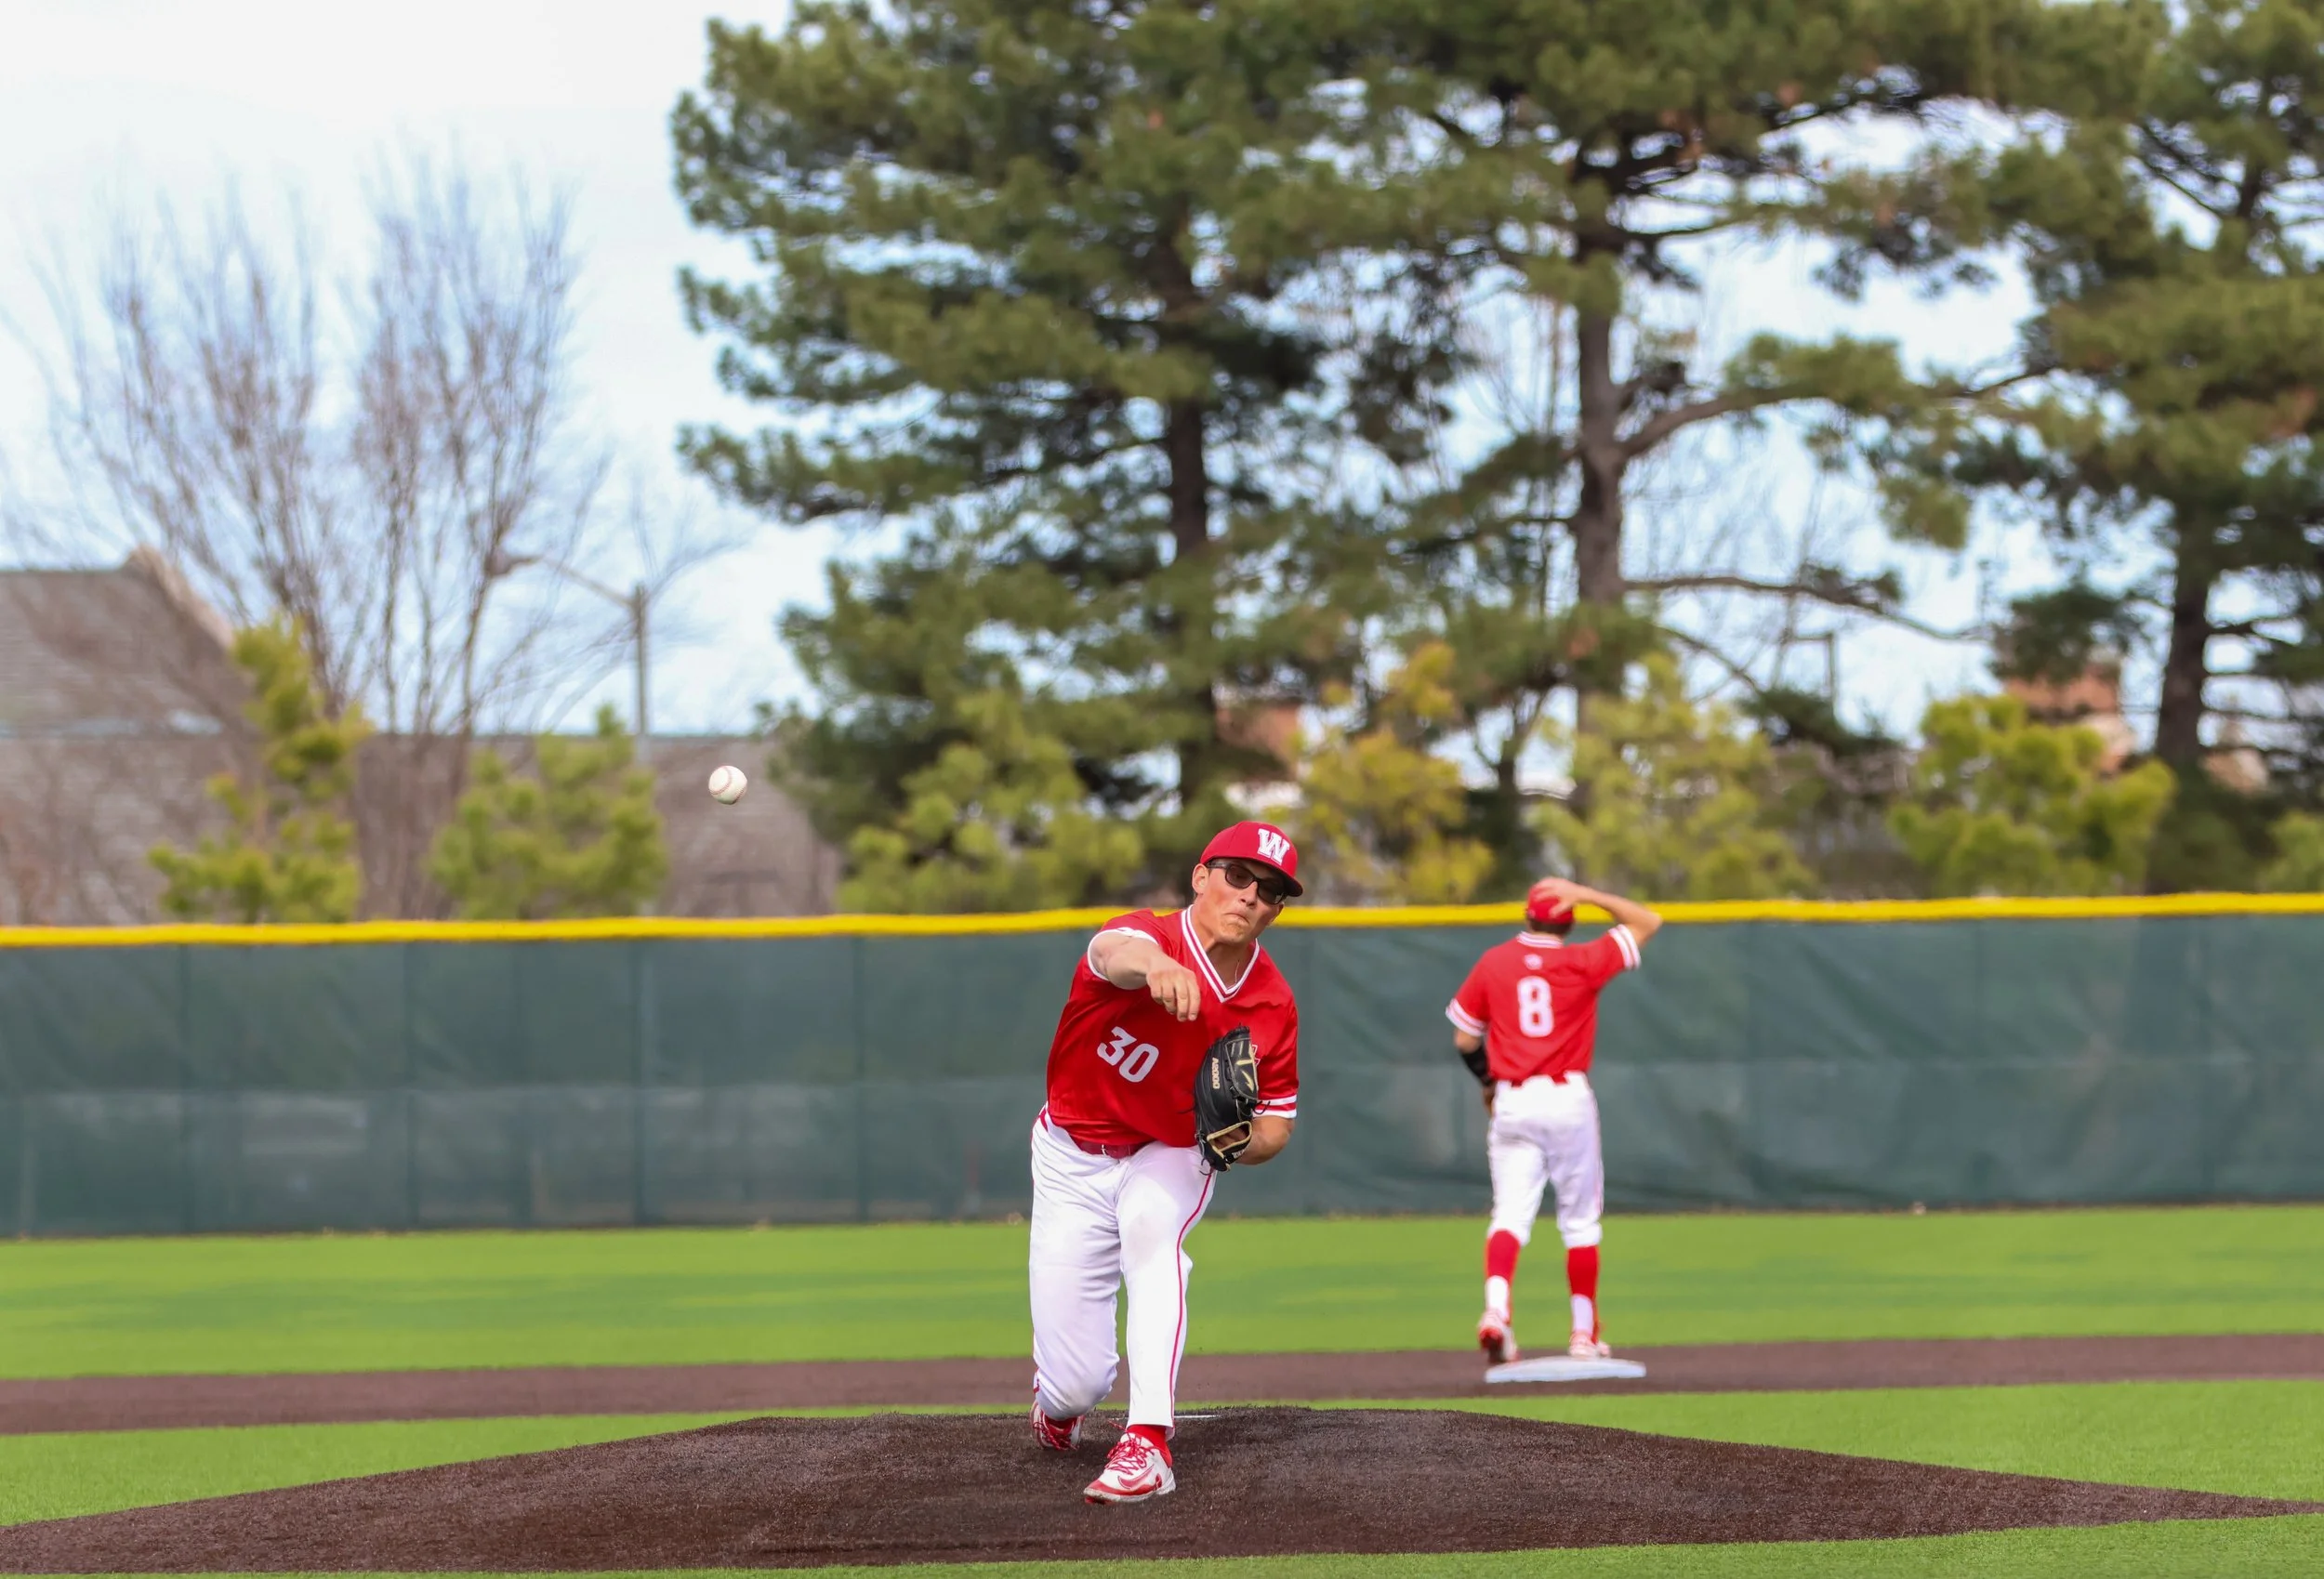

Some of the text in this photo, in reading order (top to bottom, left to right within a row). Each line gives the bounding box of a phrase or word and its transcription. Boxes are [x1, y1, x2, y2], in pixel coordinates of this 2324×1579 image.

[1257, 828, 1290, 866] W
[1517, 975, 1554, 1038] 8
[1097, 1026, 1159, 1083] 30
